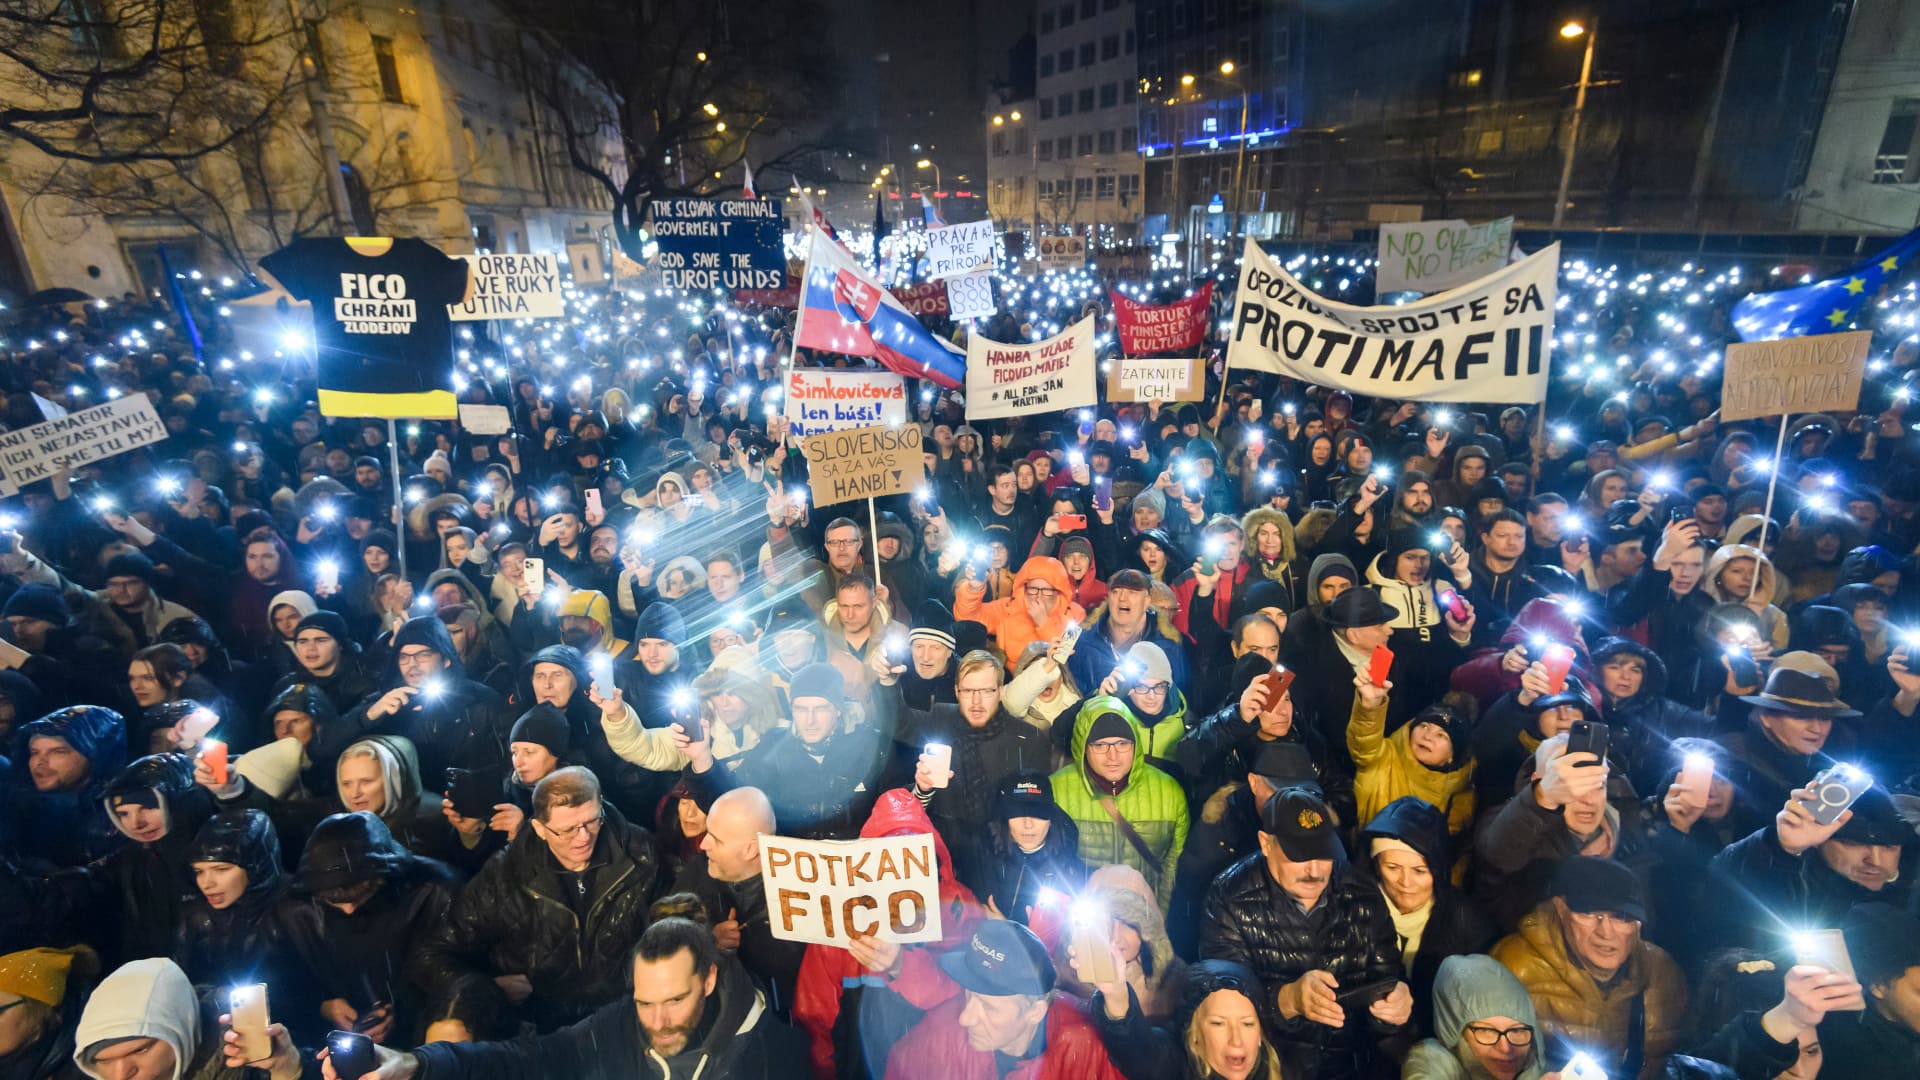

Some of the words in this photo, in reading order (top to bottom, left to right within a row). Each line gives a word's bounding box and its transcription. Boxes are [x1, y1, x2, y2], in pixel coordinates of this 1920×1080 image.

[652, 200, 672, 217] THE
[675, 200, 717, 218] SLOVAK
[720, 200, 778, 218] CRIMINAL
[951, 243, 975, 256] PRE
[1387, 231, 1424, 257] NO
[480, 256, 548, 275] ORBAN
[660, 252, 685, 268] GOD
[692, 252, 720, 268] SAVE
[730, 253, 752, 268] THE
[1405, 253, 1440, 280] NO
[340, 272, 406, 299] FICO
[506, 275, 555, 294] RUKY
[662, 269, 781, 290] EUROFUNDS
[341, 299, 411, 318] CHRÁNI
[1135, 304, 1193, 324] TORTURY
[1361, 295, 1489, 335] SPOJTE
[1503, 283, 1545, 316] SA
[344, 321, 411, 335] ZLODEJOV
[1236, 302, 1366, 376] PROTI
[1370, 324, 1543, 381] MAFII
[986, 349, 1031, 366] HANBA
[993, 366, 1033, 384] FICOVEJ
[1122, 367, 1185, 380] ZATKNITE
[790, 373, 904, 400] Šimkovičová
[1004, 388, 1019, 401] ALL
[1023, 385, 1038, 397] FOR
[1042, 378, 1064, 392] JAN
[1139, 383, 1171, 398] ICH!
[801, 402, 829, 420] len
[835, 402, 882, 421] búši!
[1012, 394, 1049, 408] MARTINA
[31, 406, 115, 440] SEMAFOR
[40, 411, 152, 455] NEZASTAVIL
[13, 462, 48, 483] TAK
[52, 447, 93, 470] SME
[93, 437, 123, 456] TU
[127, 421, 165, 445] MY!
[810, 428, 920, 463] SLOVENSKO
[822, 463, 840, 479] SA
[844, 459, 863, 474] ZA
[867, 453, 896, 469] VÁS
[767, 845, 930, 887] POTKAN
[779, 887, 926, 940] FICO
